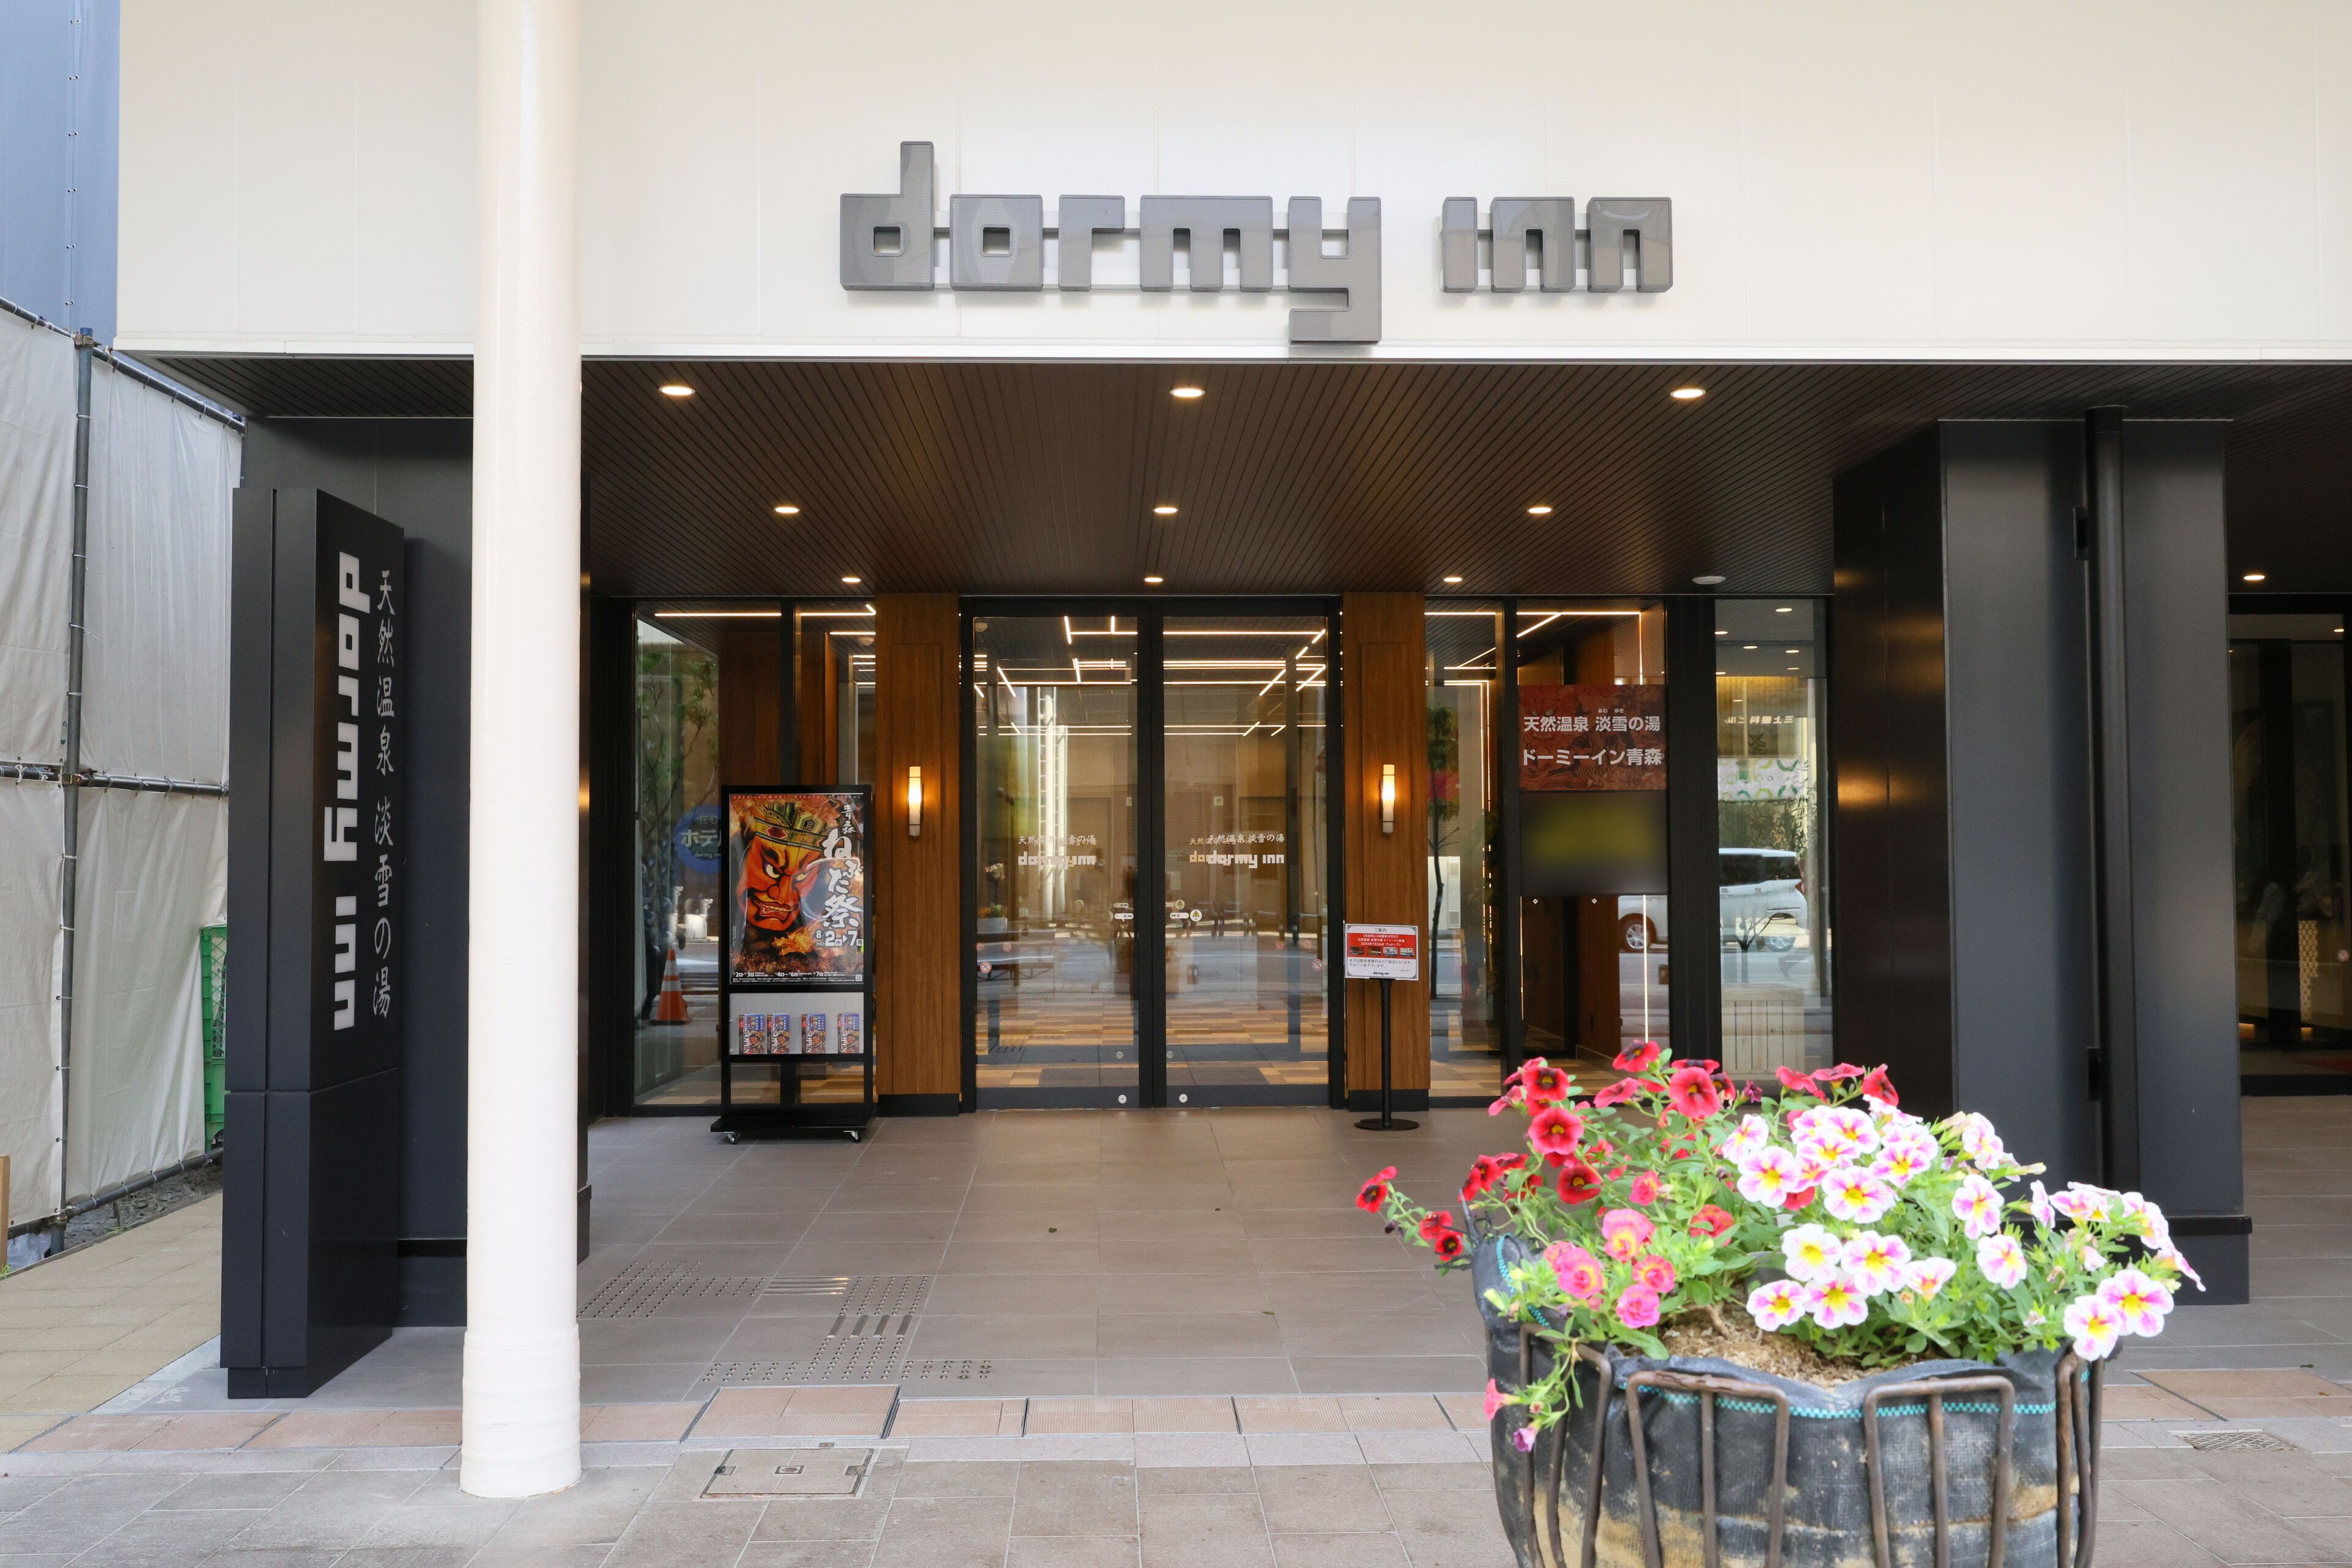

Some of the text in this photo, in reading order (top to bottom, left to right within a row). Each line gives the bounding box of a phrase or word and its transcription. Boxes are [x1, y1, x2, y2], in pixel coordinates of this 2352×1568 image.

[840, 141, 1673, 345] dormy inn
[1523, 715, 1660, 733] 天然温泉 淡雪の湯
[1523, 748, 1662, 766] ドーミーイン青森
[324, 551, 370, 1031] dormy inn
[372, 570, 395, 1020] 天然温泉 淡雪の湯
[1207, 850, 1258, 869] dormy
[1262, 854, 1284, 864] inn
